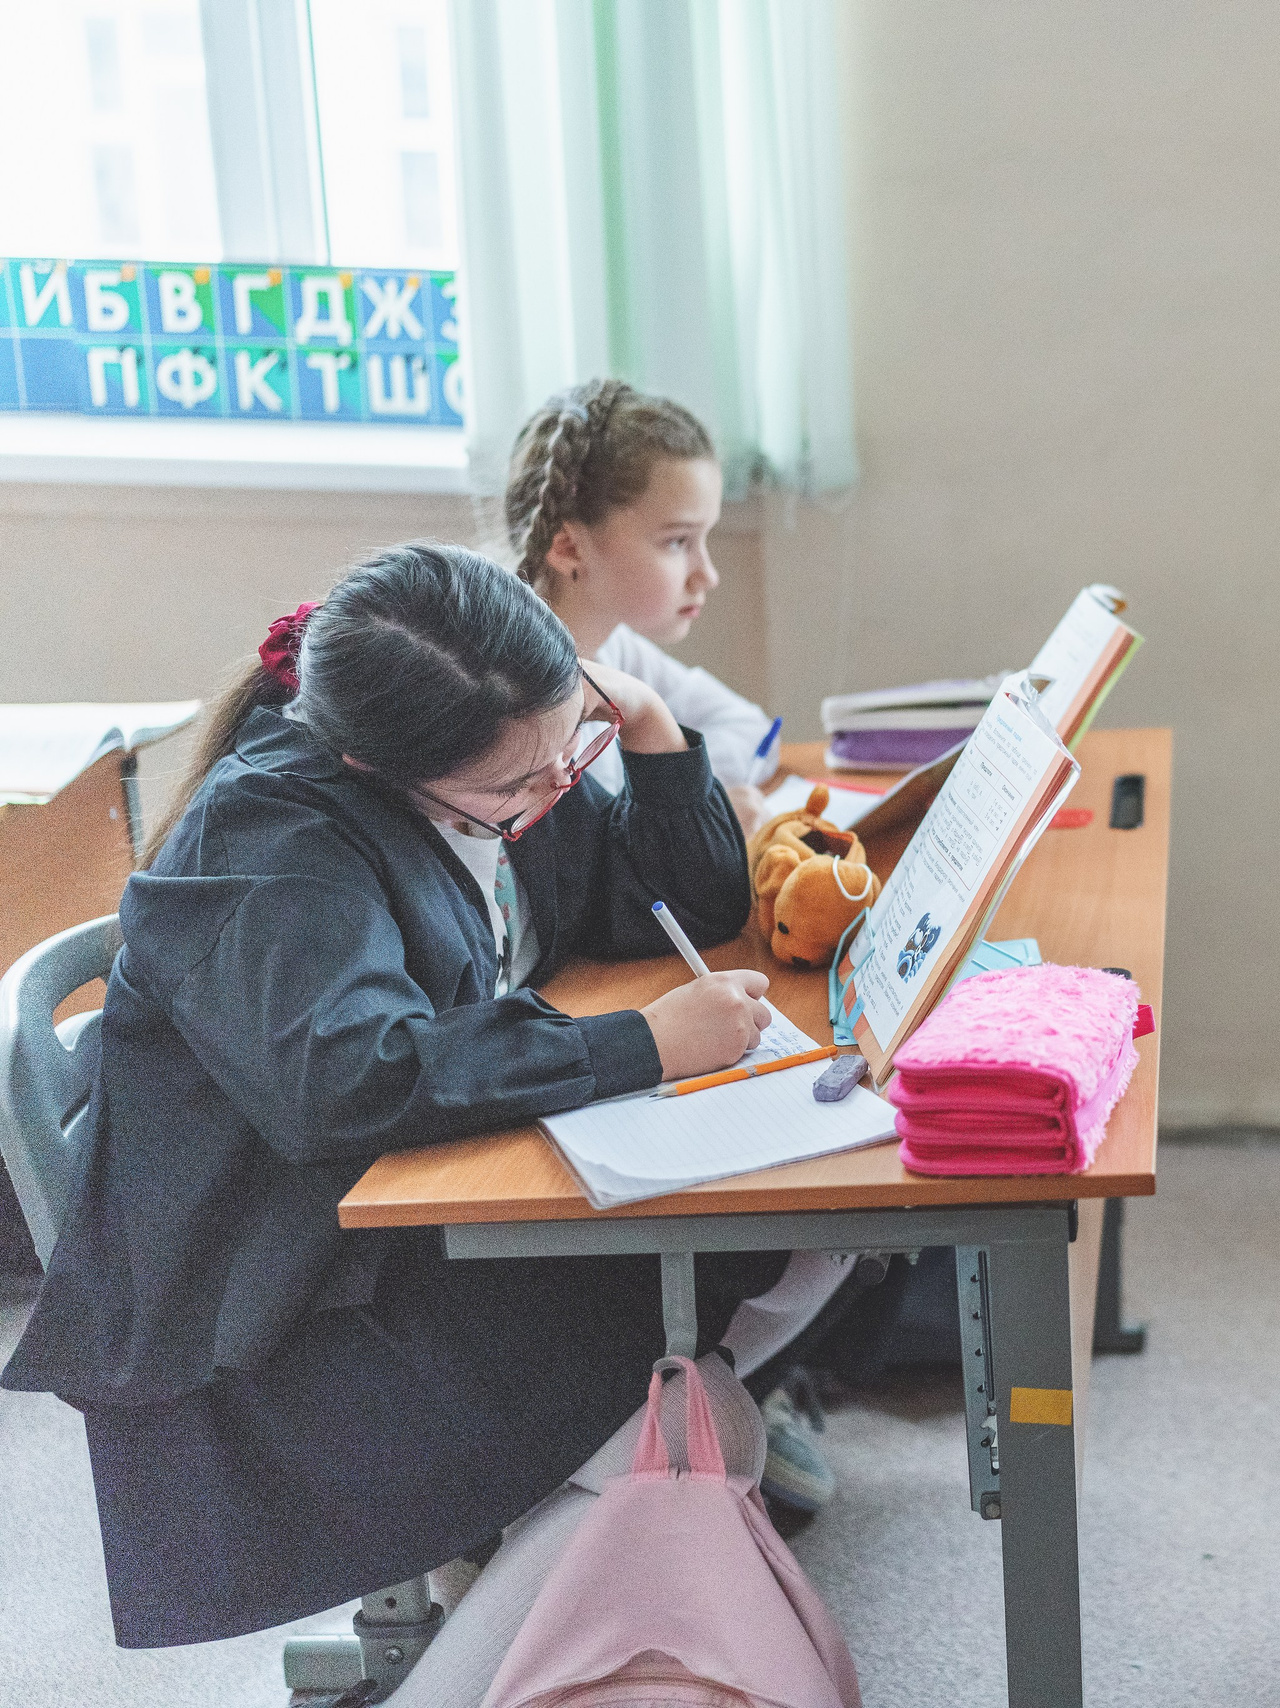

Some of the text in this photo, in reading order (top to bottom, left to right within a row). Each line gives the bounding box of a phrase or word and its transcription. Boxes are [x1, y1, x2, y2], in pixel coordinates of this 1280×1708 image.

[84, 269, 131, 332] Б
[159, 270, 204, 334] В
[232, 272, 276, 335] Г
[295, 275, 352, 347] Д
[361, 276, 424, 341] Ж
[87, 347, 140, 408] П
[157, 347, 217, 409] Ф
[236, 351, 283, 412] К
[307, 353, 353, 414] Т
[368, 354, 431, 415] Ш
